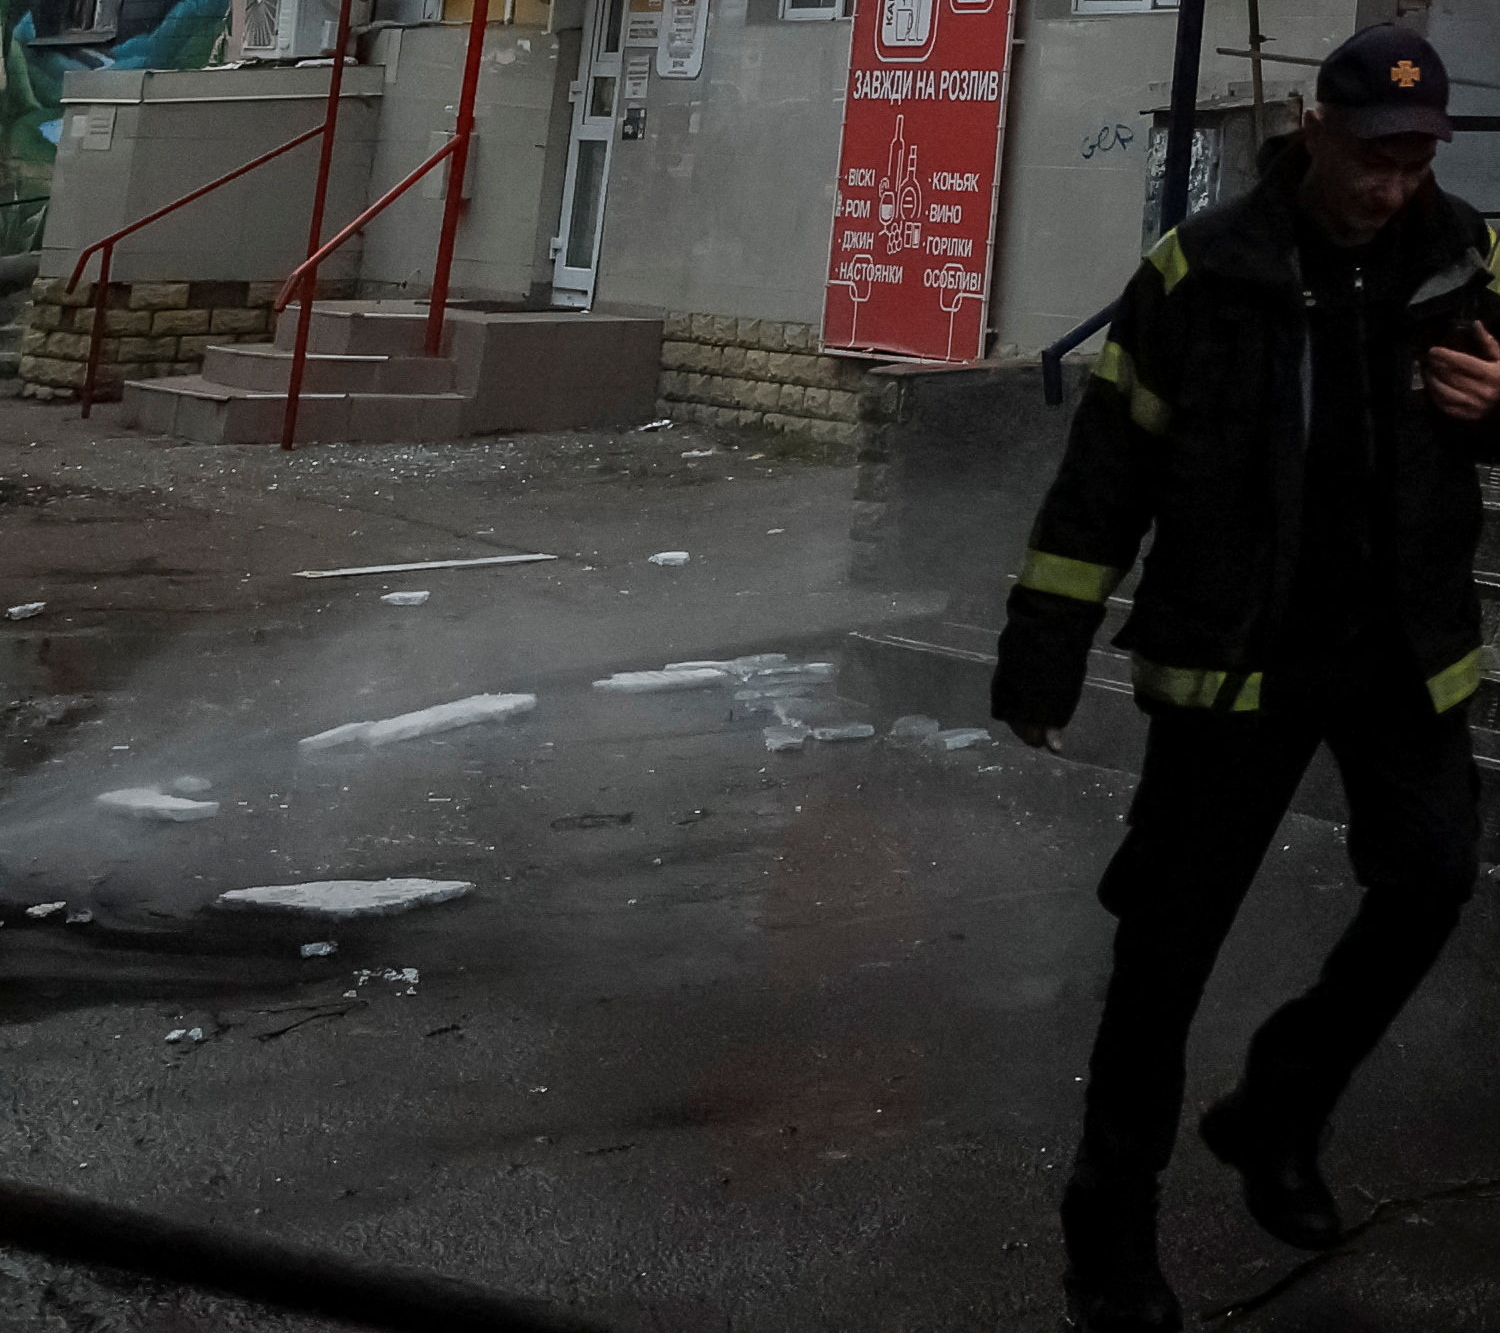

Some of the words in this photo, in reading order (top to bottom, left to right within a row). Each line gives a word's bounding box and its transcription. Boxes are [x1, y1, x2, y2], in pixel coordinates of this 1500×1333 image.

[853, 69, 913, 105] ЗАВЖДИ
[915, 70, 935, 100] НА
[939, 70, 999, 101] РОЗЛИВ
[848, 168, 876, 187] ВІСКІ
[932, 172, 980, 192] КОНЬЯК
[845, 199, 871, 218] РОМ
[929, 204, 962, 224] ВИНО
[842, 230, 874, 251] ДЖИН
[926, 236, 972, 258] ГОРІЛКИ
[839, 261, 903, 284] НАСТОЯНКИ
[923, 268, 982, 291] ОСОБЛИВІ
